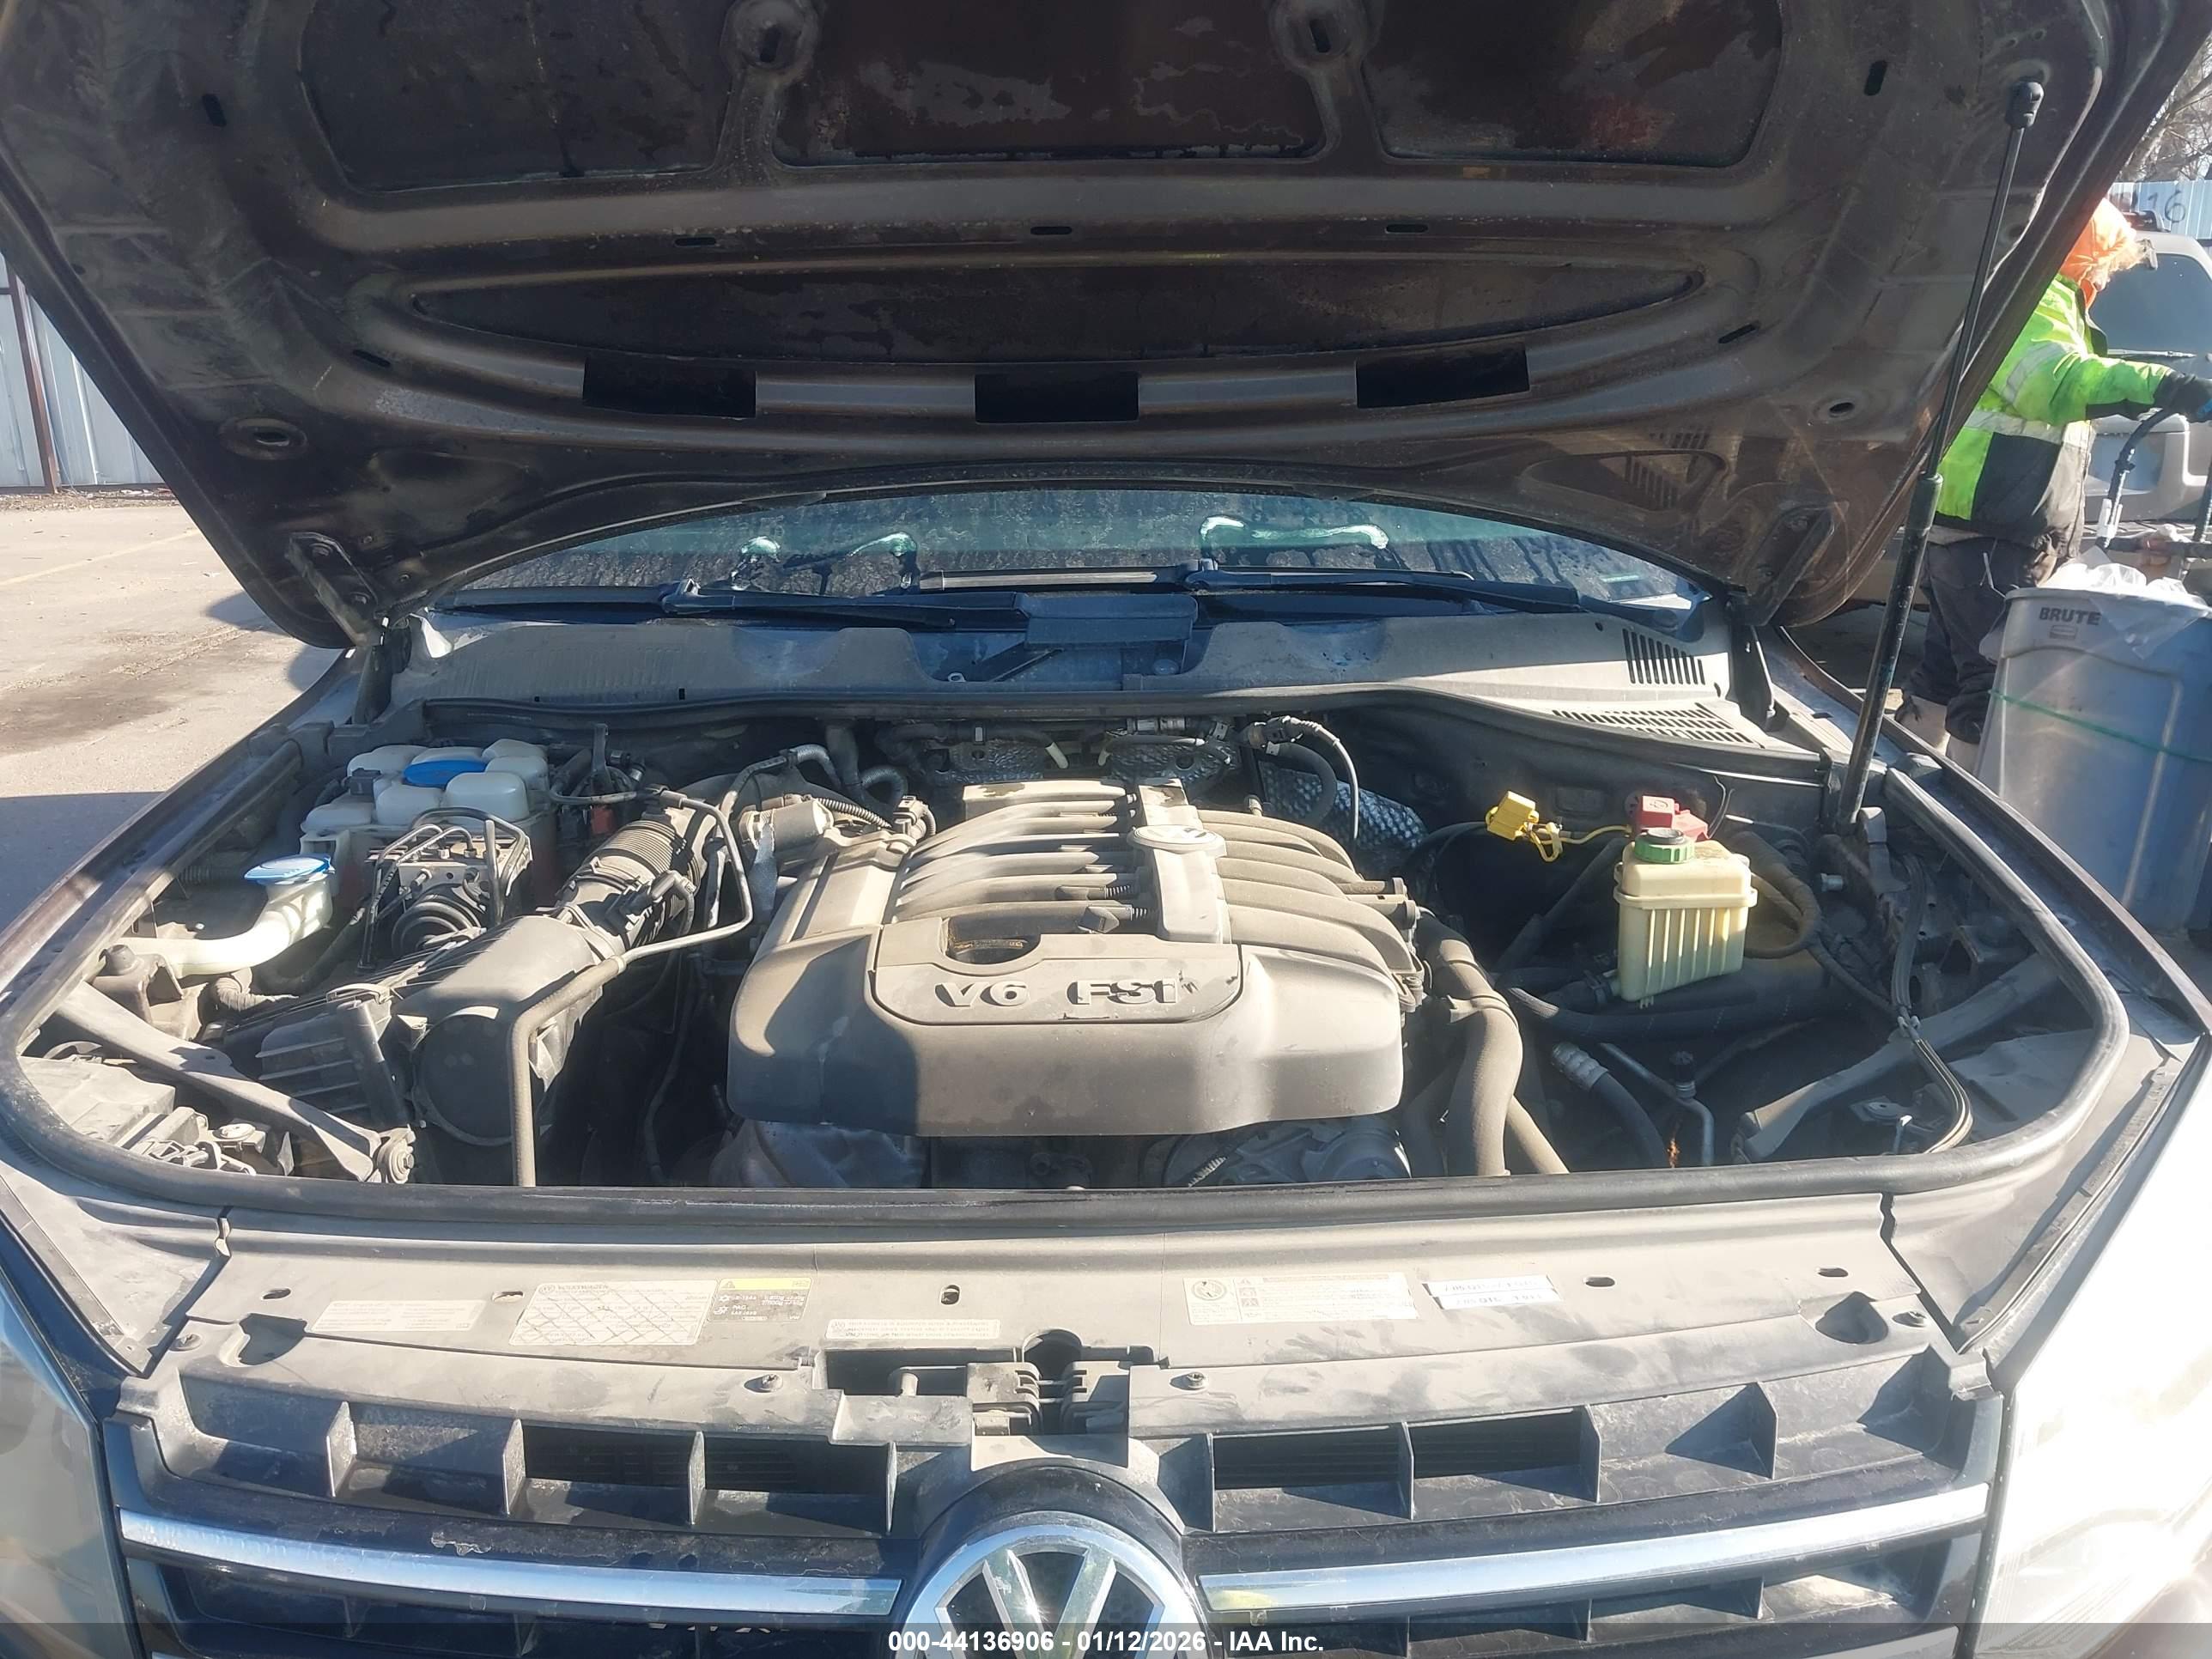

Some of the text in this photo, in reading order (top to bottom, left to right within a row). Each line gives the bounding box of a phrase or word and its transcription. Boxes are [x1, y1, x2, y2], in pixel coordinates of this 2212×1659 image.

[2039, 606, 2102, 626] BRUTE
[936, 977, 1178, 1007] V6 FSI
